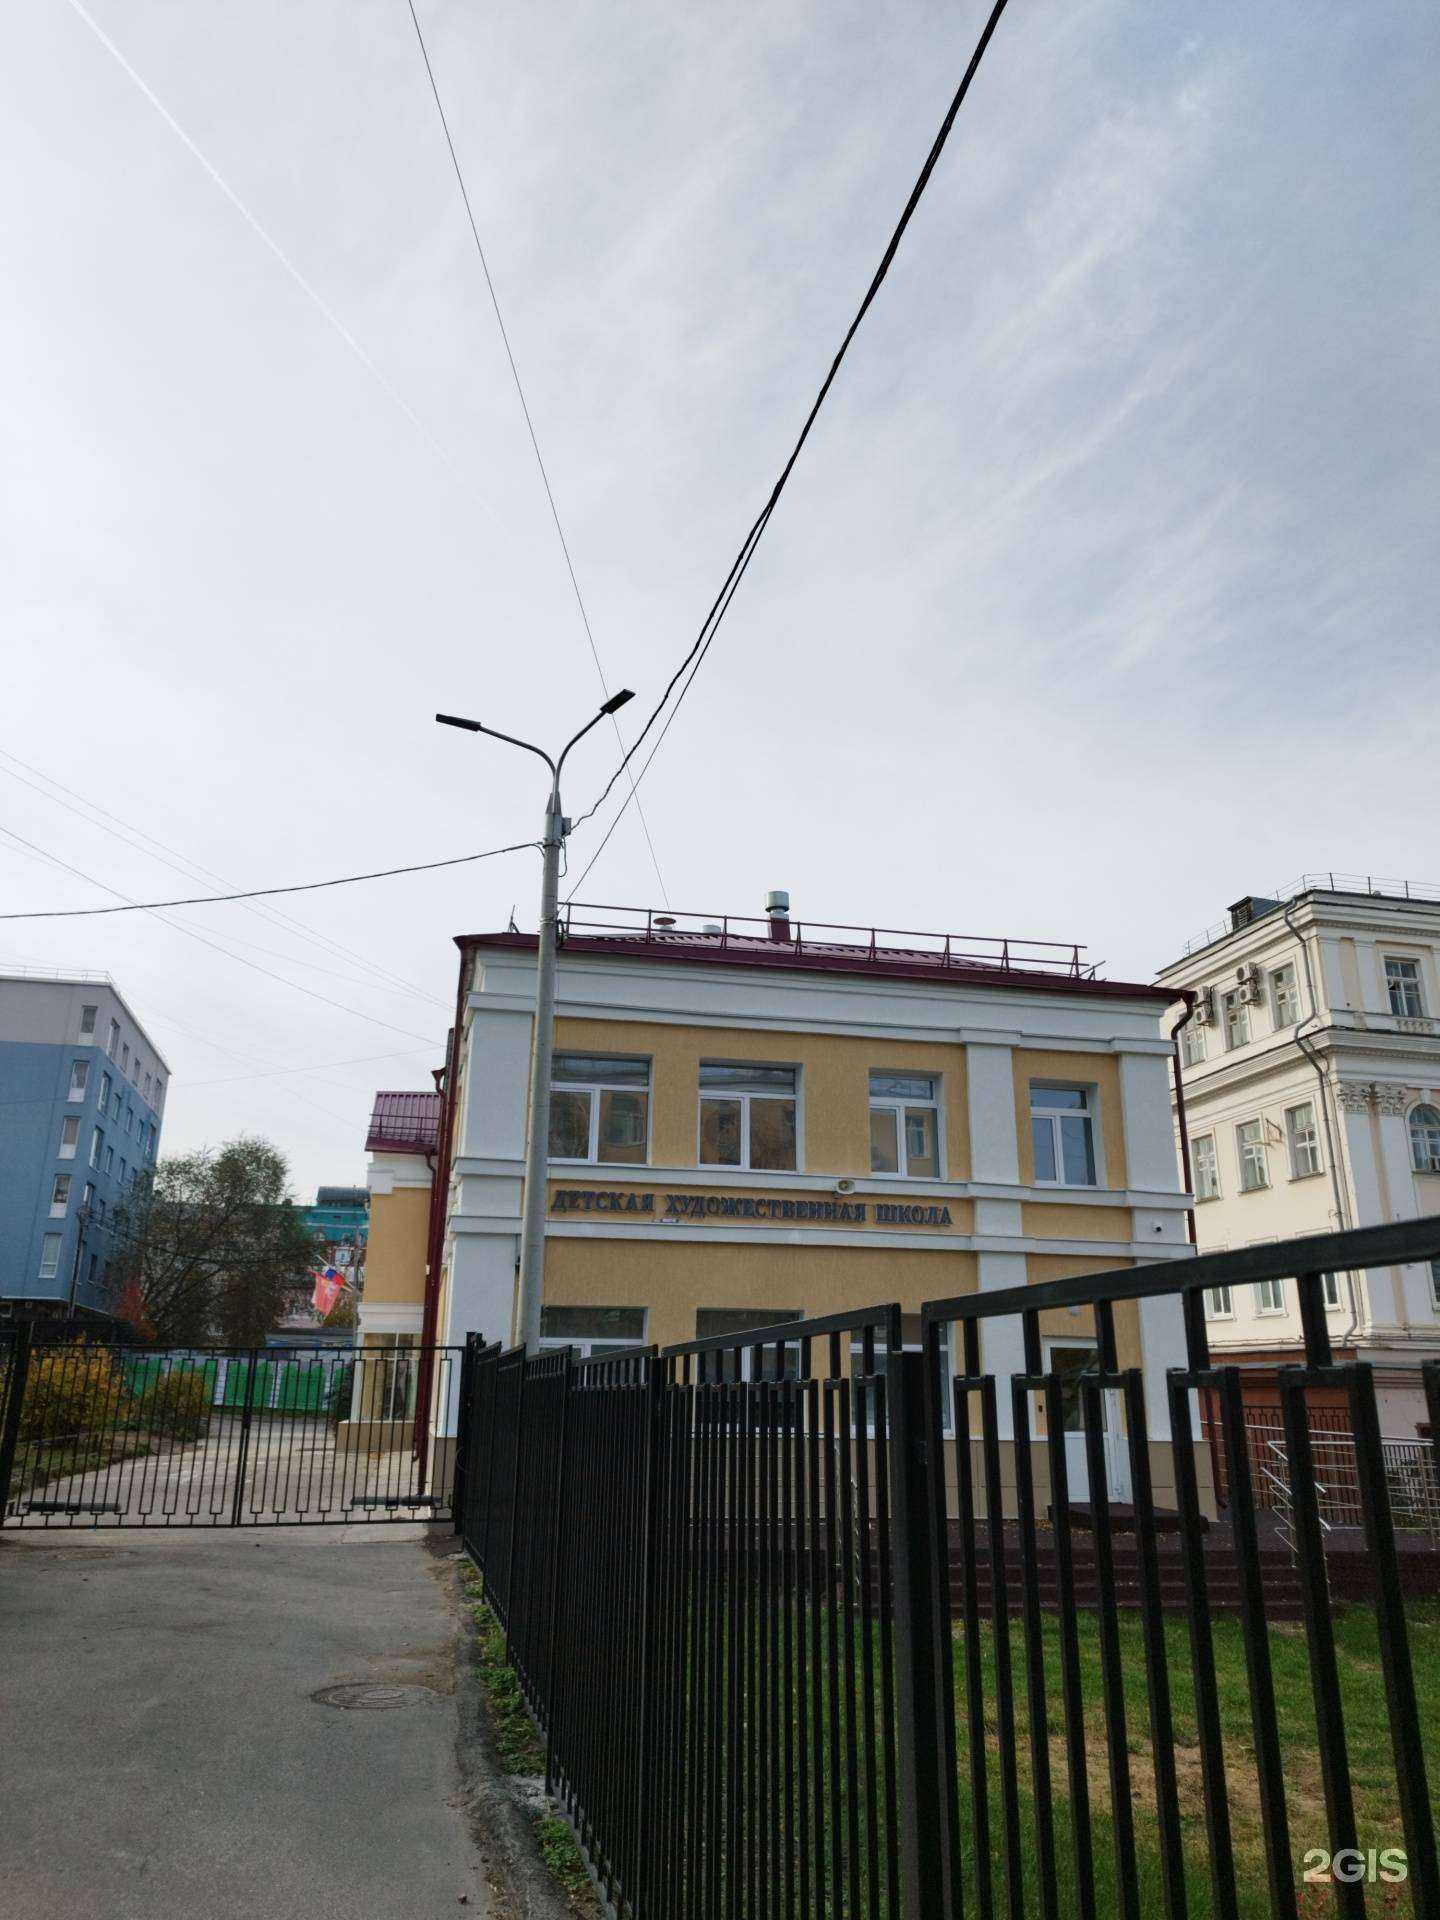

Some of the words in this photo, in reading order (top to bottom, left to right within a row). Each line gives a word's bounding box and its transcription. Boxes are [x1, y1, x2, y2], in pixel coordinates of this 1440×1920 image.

[551, 1190, 655, 1213] ДЕТСКАЯ
[665, 1194, 866, 1222] ХУДОЖЕСТВЕННАЯ
[875, 1204, 953, 1225] ШКОЛА
